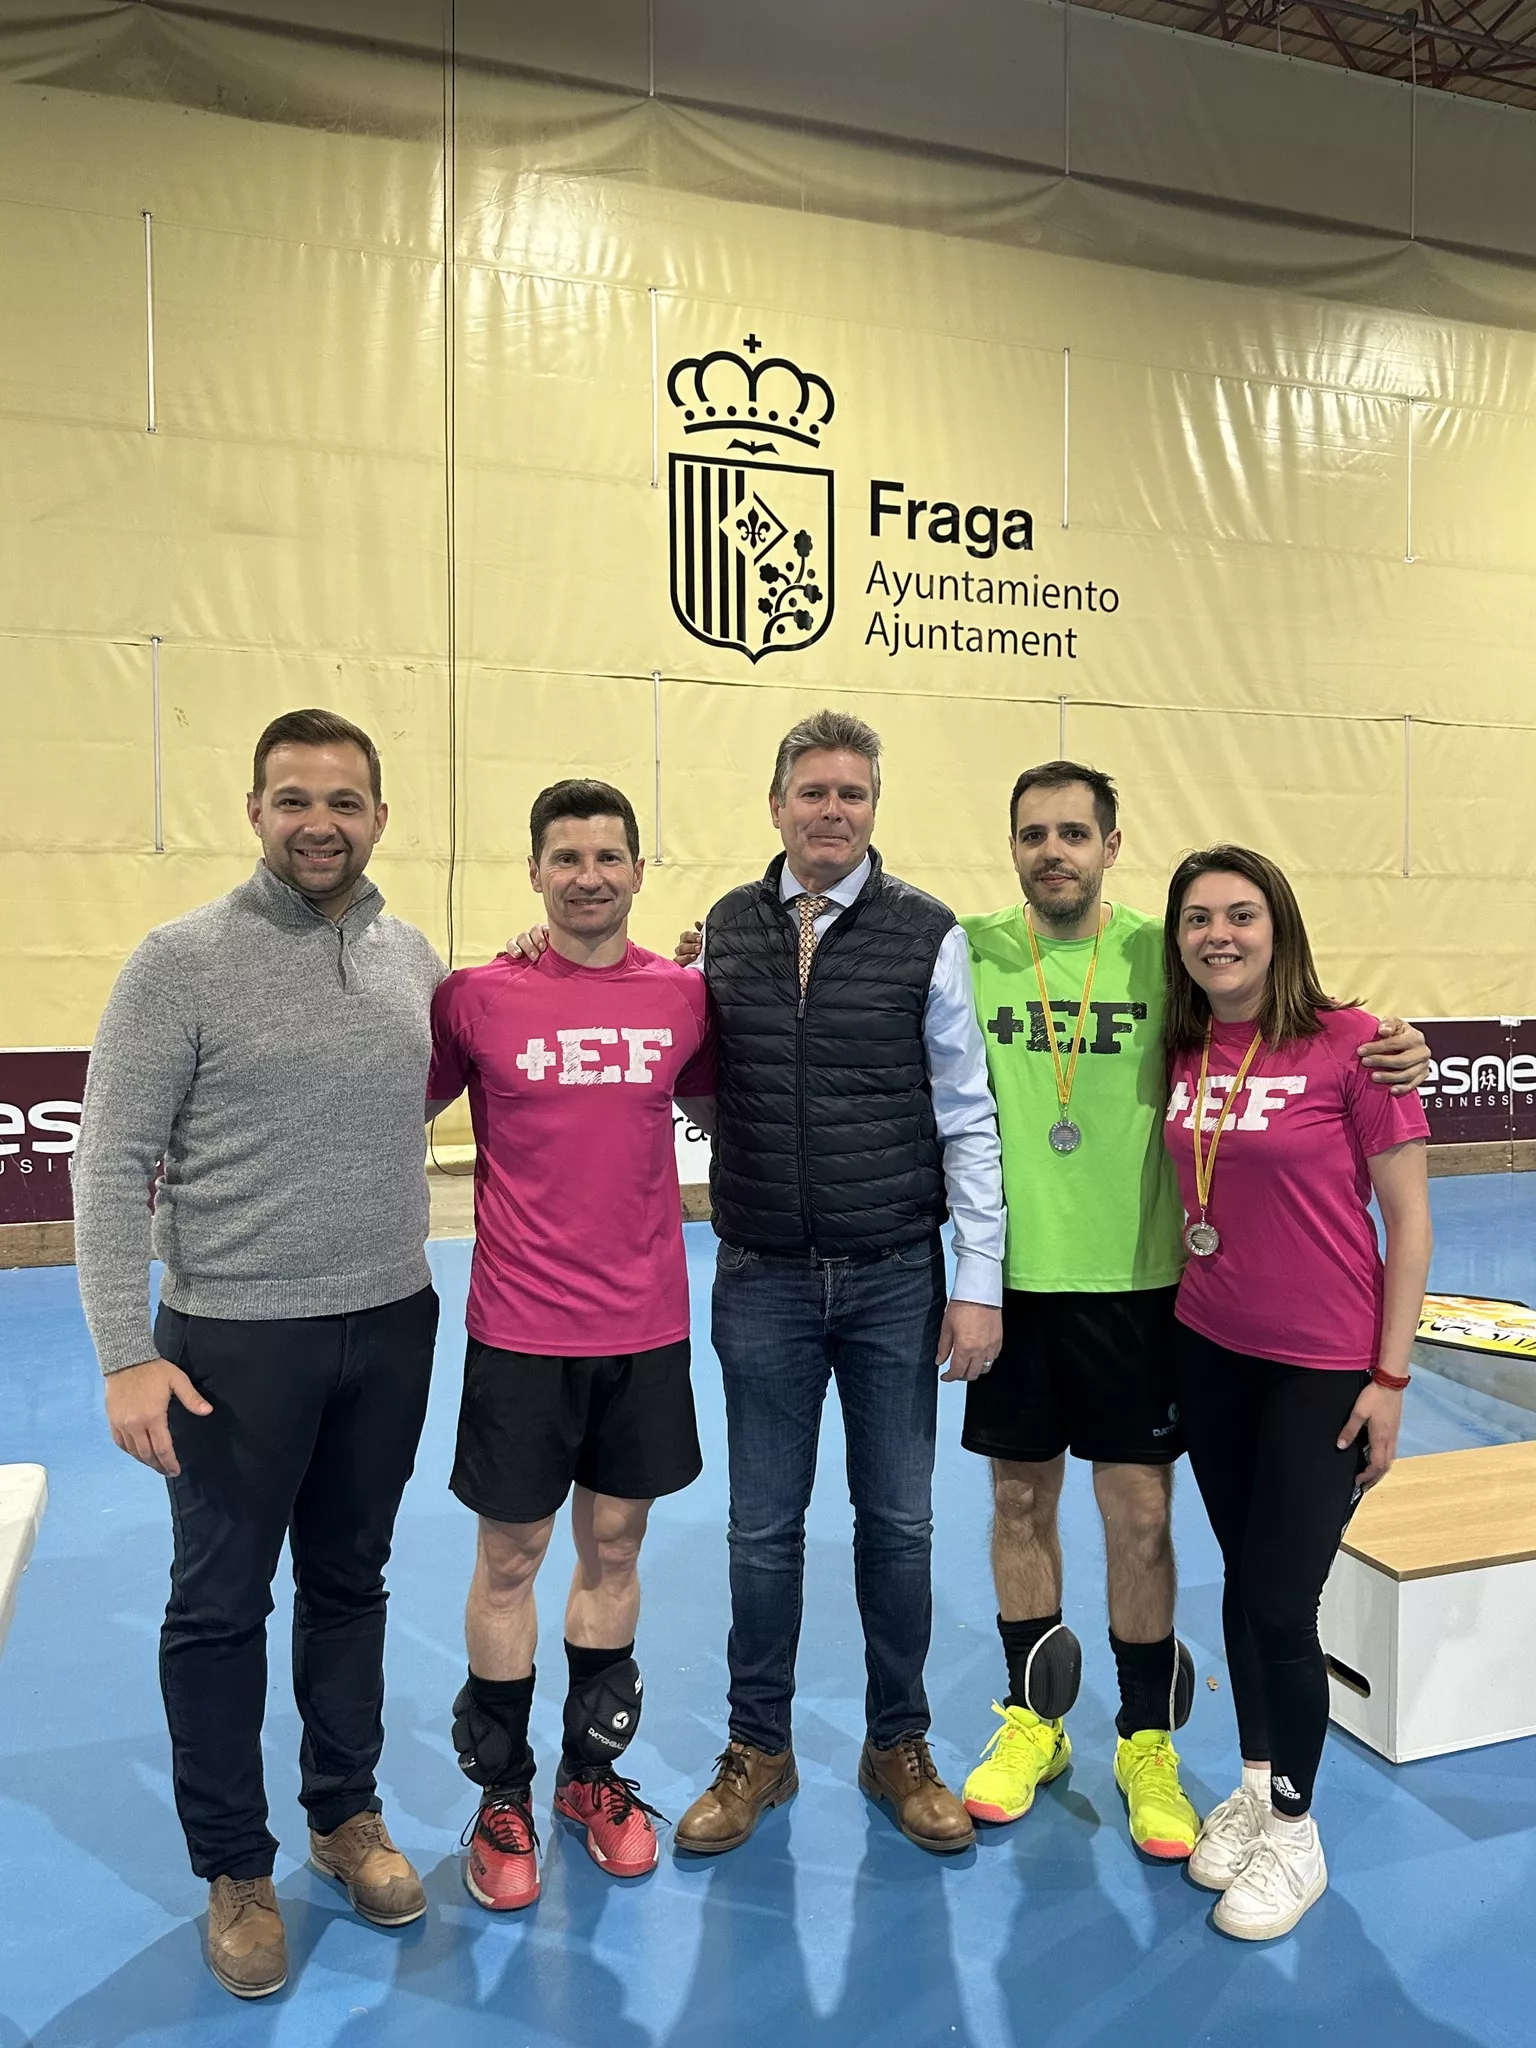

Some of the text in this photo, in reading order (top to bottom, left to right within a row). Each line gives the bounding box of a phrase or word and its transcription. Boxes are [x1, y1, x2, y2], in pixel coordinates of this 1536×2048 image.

[869, 479, 1034, 560] Fraga
[865, 559, 1121, 614] Ayuntamiento
[864, 610, 1078, 659] Ajuntament
[515, 1026, 673, 1086] +EF
